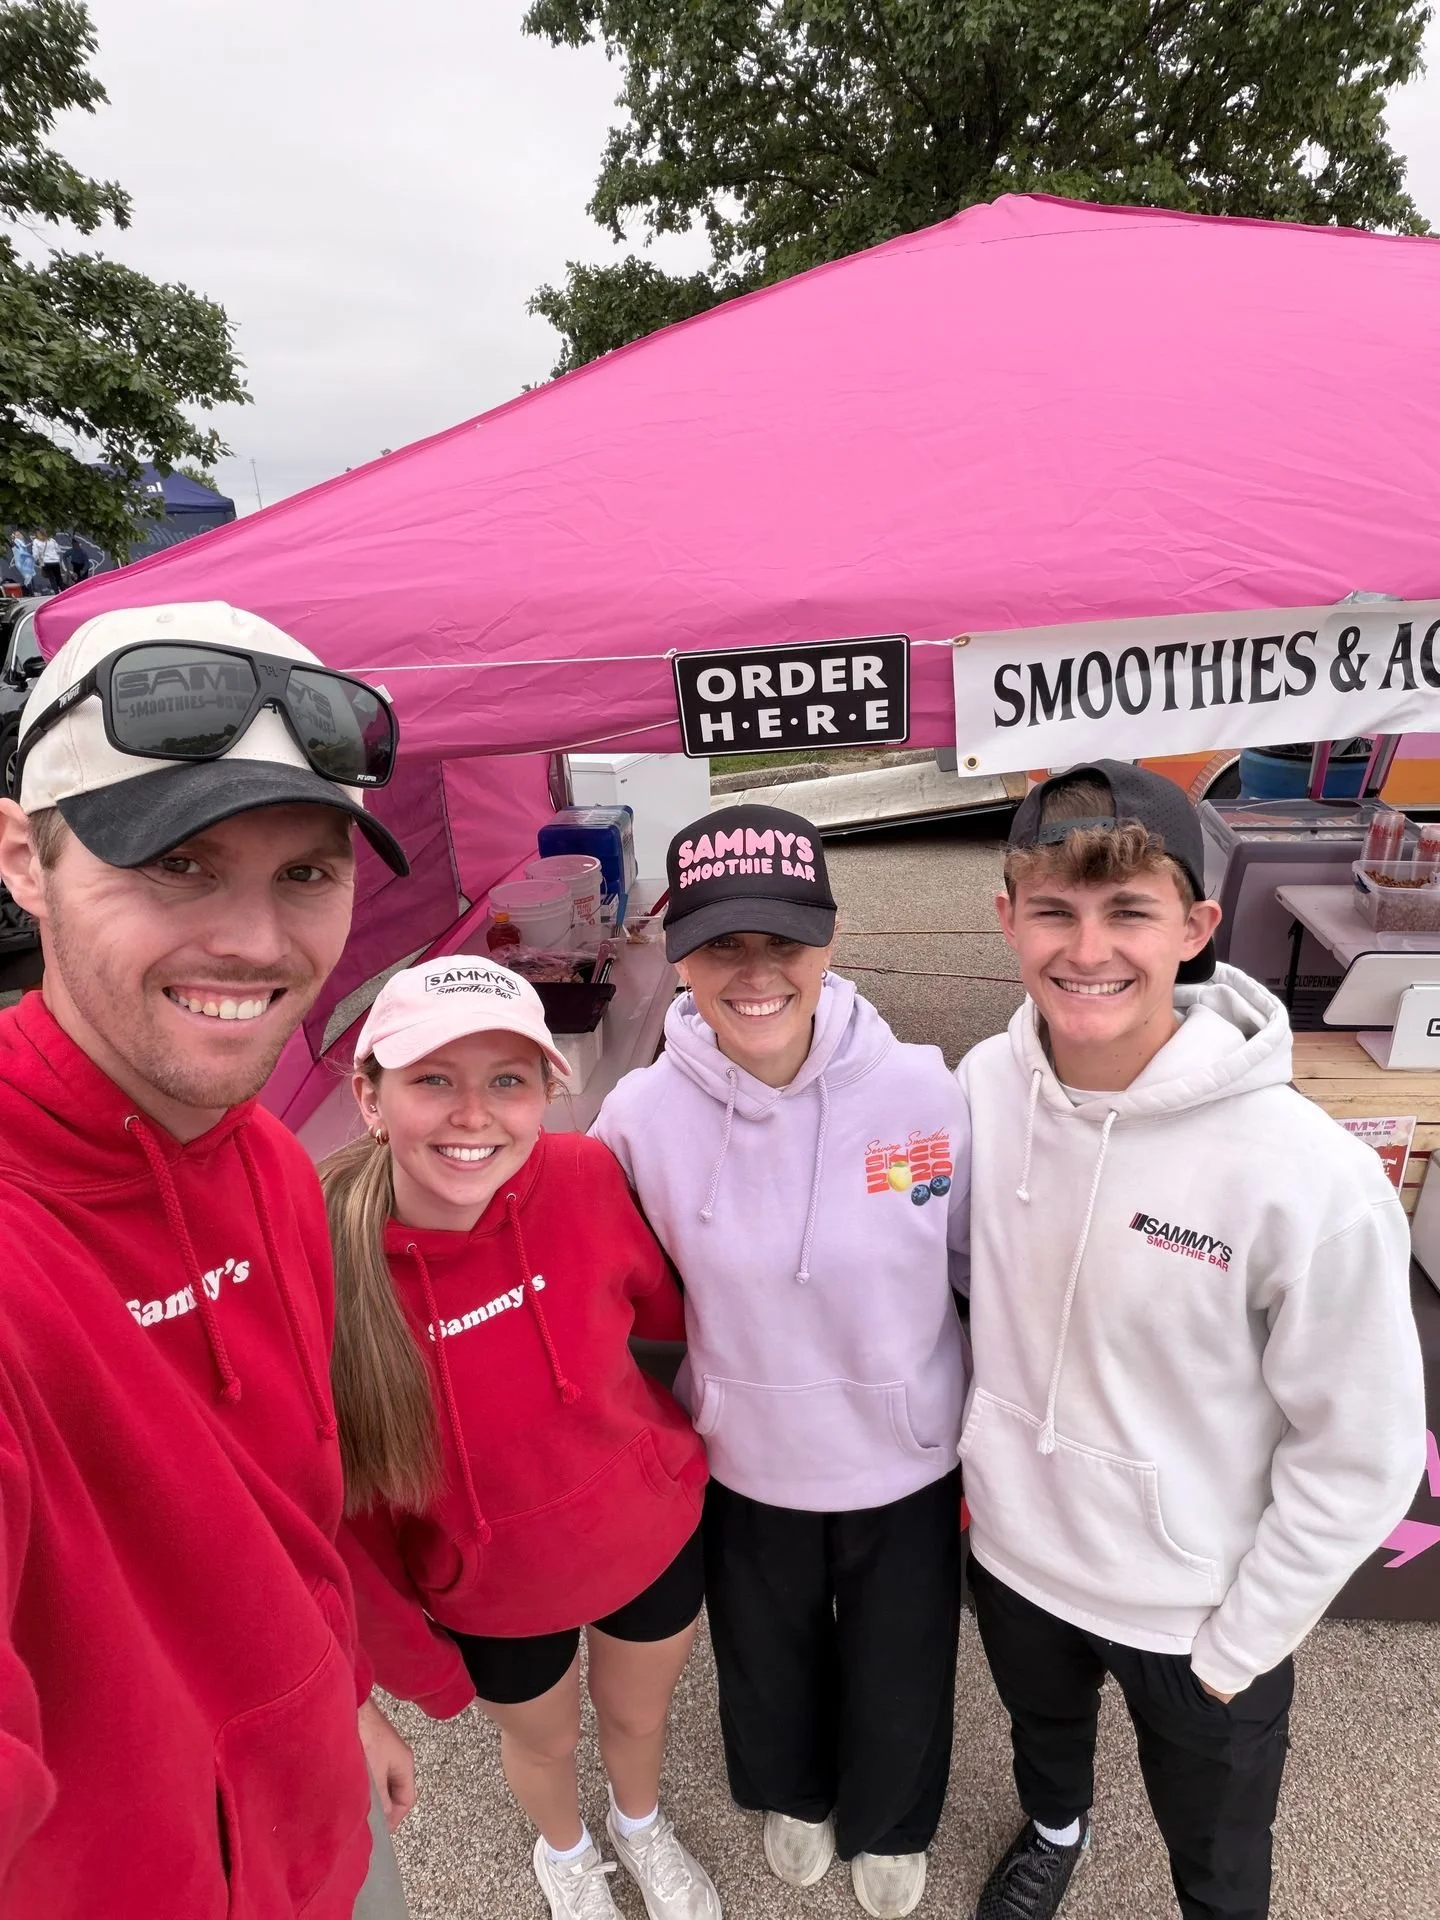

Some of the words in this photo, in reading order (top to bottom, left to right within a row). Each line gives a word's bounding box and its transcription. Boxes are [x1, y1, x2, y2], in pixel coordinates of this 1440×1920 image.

[696, 655, 888, 702] ORDER
[993, 630, 1319, 728] SMOOTHIES
[1329, 625, 1371, 693] &
[678, 828, 815, 869] SAMMYS
[679, 858, 773, 889] SMOOTHIE
[781, 859, 816, 883] BAR
[430, 970, 516, 990] SAMMY'S
[905, 1126, 950, 1147] Smoothies
[866, 1160, 953, 1194] 220
[1143, 1217, 1233, 1263] SAMMY'S
[1146, 1235, 1206, 1261] SMOOTHIE
[1208, 1254, 1229, 1272] BAR
[428, 1274, 546, 1341] Sammys
